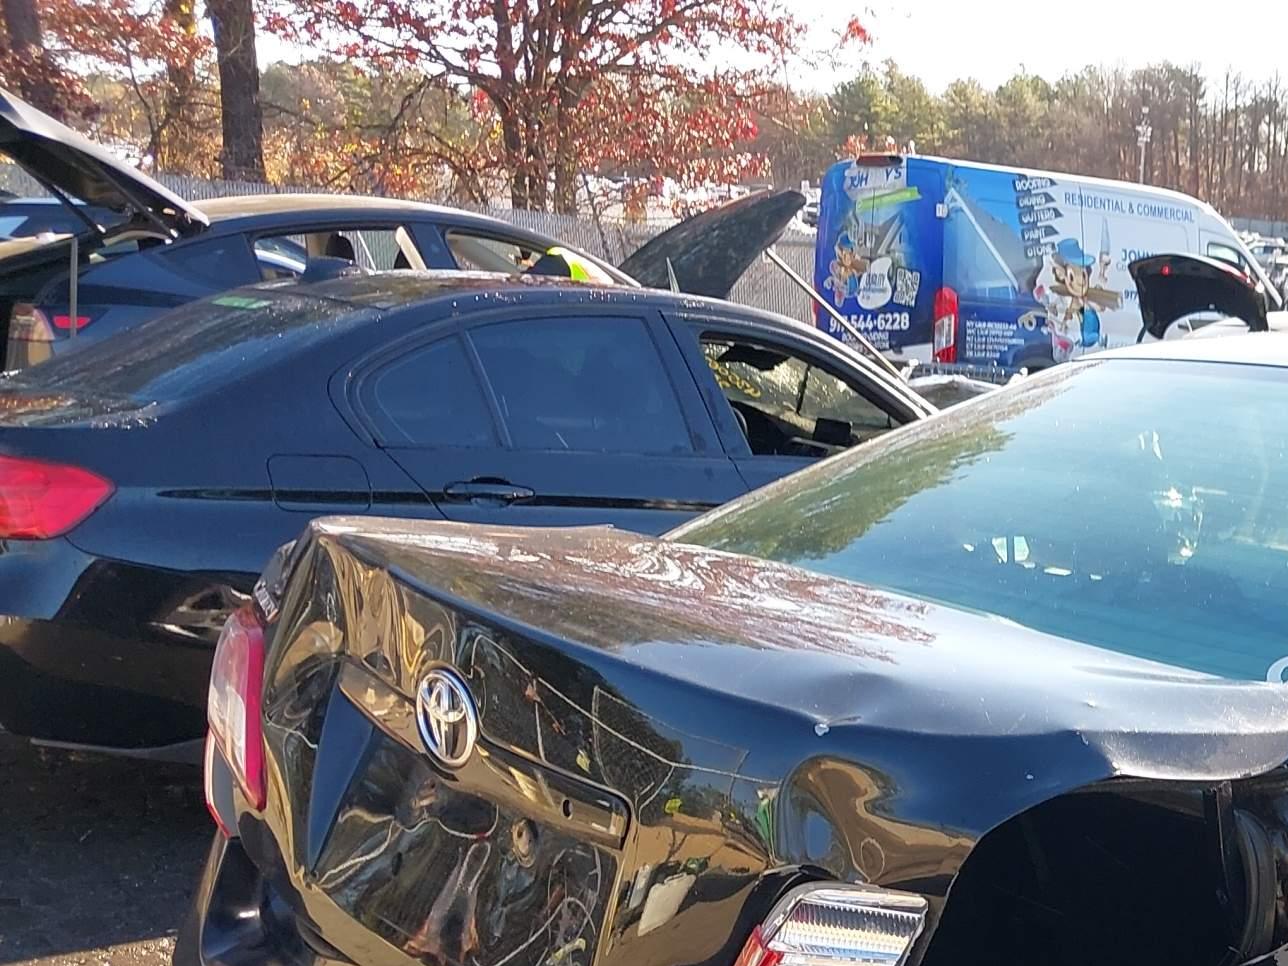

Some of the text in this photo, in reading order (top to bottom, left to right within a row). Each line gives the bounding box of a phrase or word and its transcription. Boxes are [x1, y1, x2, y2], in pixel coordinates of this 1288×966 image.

[1064, 192, 1195, 223] RESIDENTIAL & COMMERCIAL
